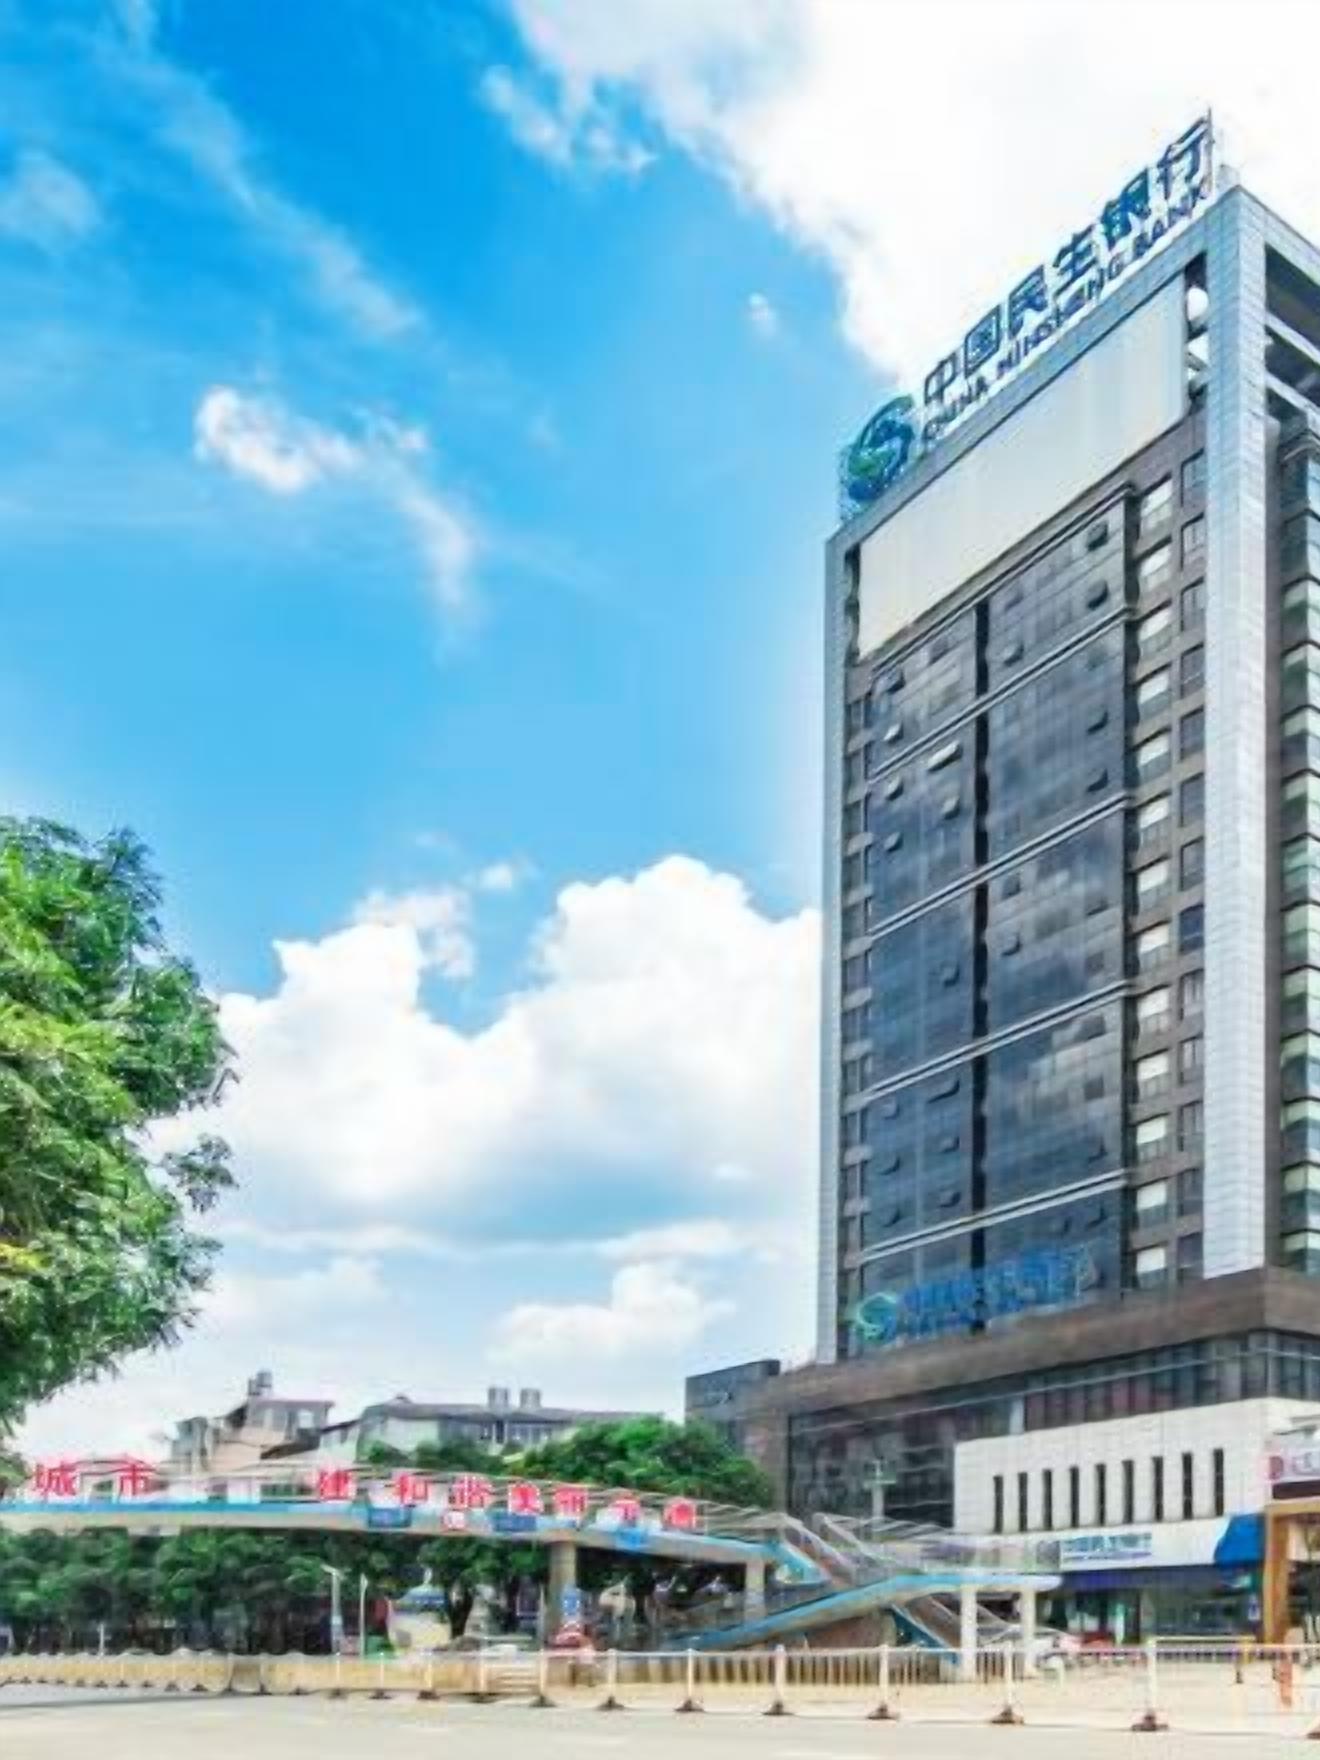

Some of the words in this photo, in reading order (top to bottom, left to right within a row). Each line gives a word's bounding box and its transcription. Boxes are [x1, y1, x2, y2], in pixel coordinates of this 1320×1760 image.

[924, 116, 1209, 405] 中国民生银行
